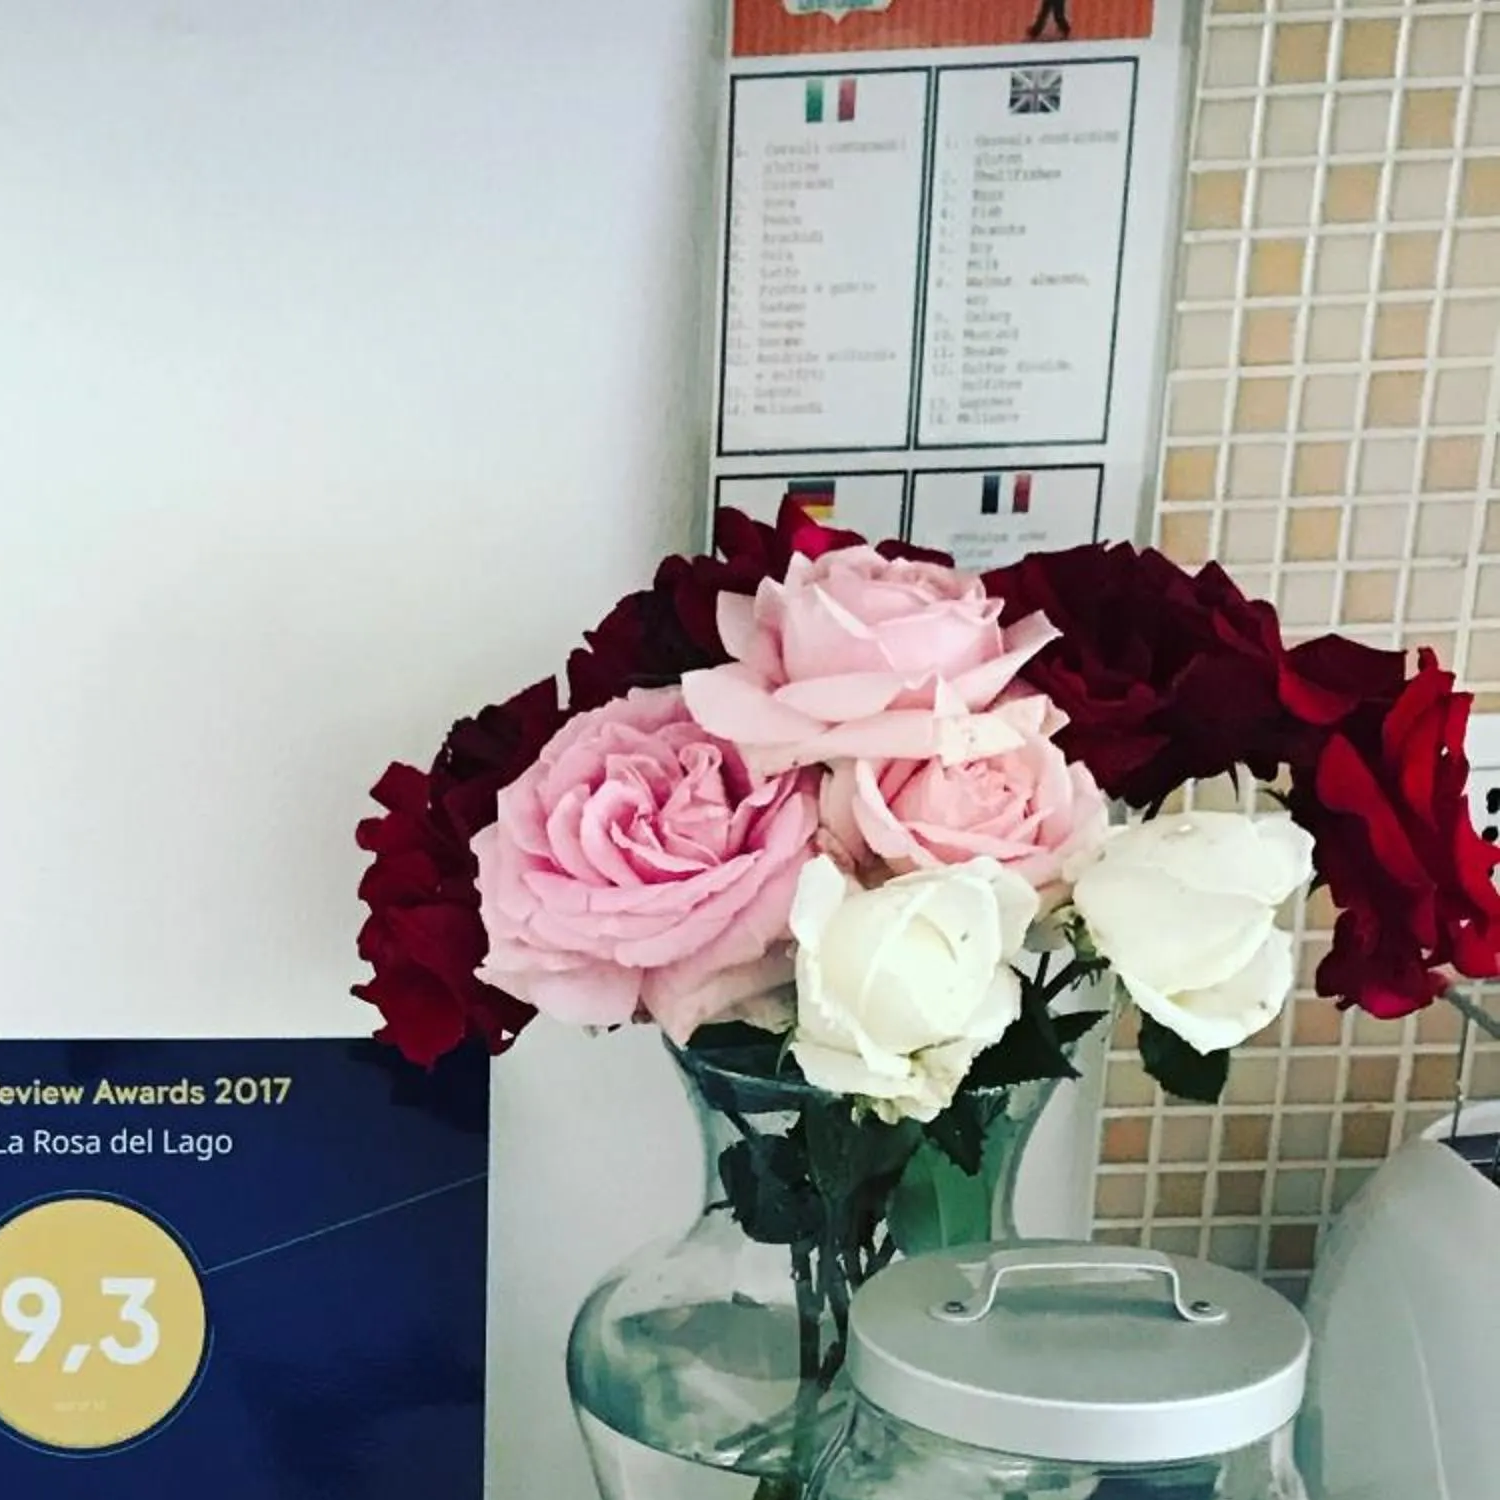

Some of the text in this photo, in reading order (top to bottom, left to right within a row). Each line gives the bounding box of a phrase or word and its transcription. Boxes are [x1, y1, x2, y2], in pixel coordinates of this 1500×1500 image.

[93, 1078, 206, 1106] Awards
[214, 1077, 292, 1105] 2017
[34, 1130, 101, 1155] Rosa
[110, 1128, 153, 1155] del
[162, 1129, 234, 1161] Lago
[1, 1276, 160, 1374] 9,3
